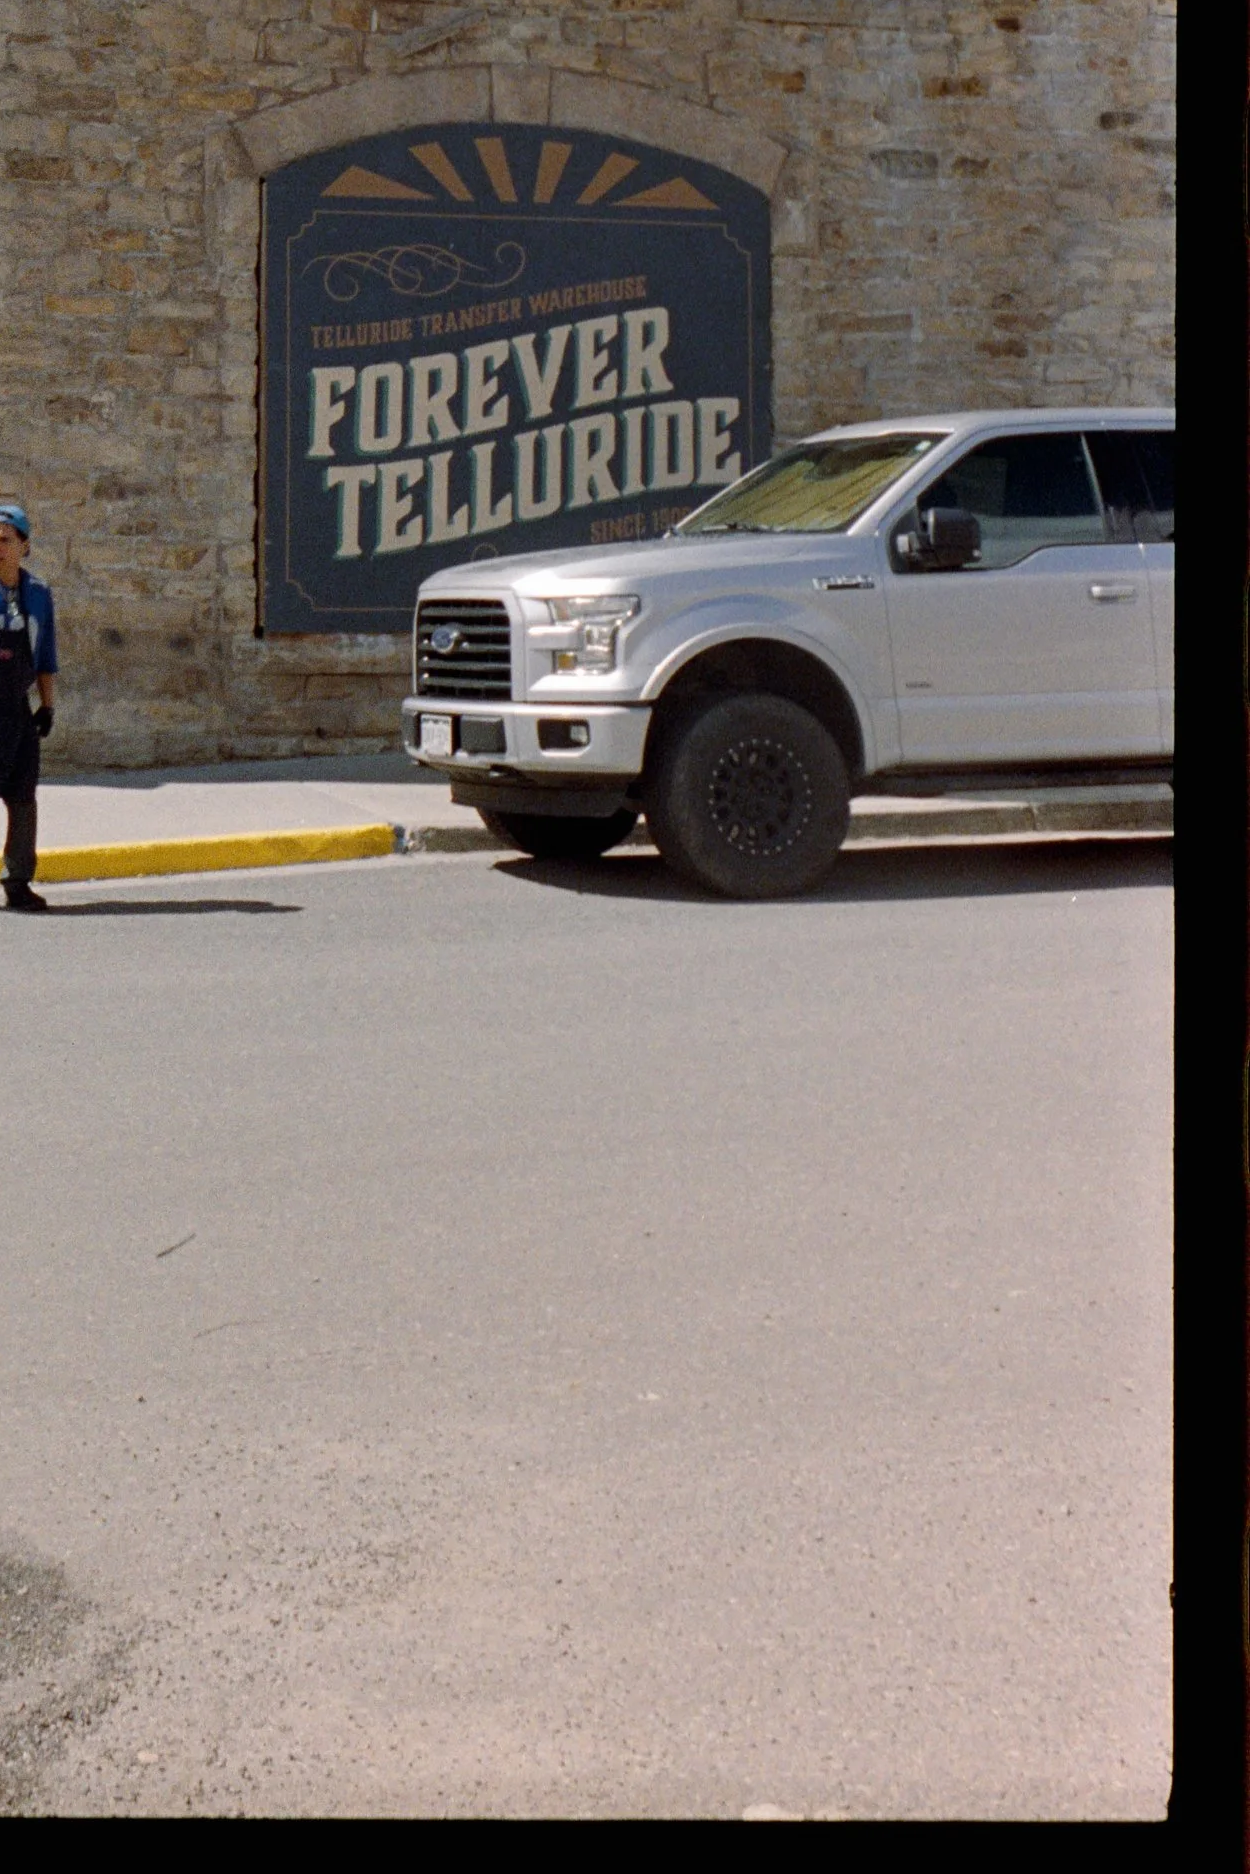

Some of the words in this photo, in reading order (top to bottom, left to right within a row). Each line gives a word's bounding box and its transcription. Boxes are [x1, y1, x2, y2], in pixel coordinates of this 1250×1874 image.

[311, 317, 414, 349] TELLURIDE
[420, 298, 523, 337] TRANSFER
[528, 275, 647, 317] WAREHOUSE
[306, 306, 675, 459] FOREVER
[324, 397, 743, 560] TELLURIDE
[590, 512, 647, 544] SINCE
